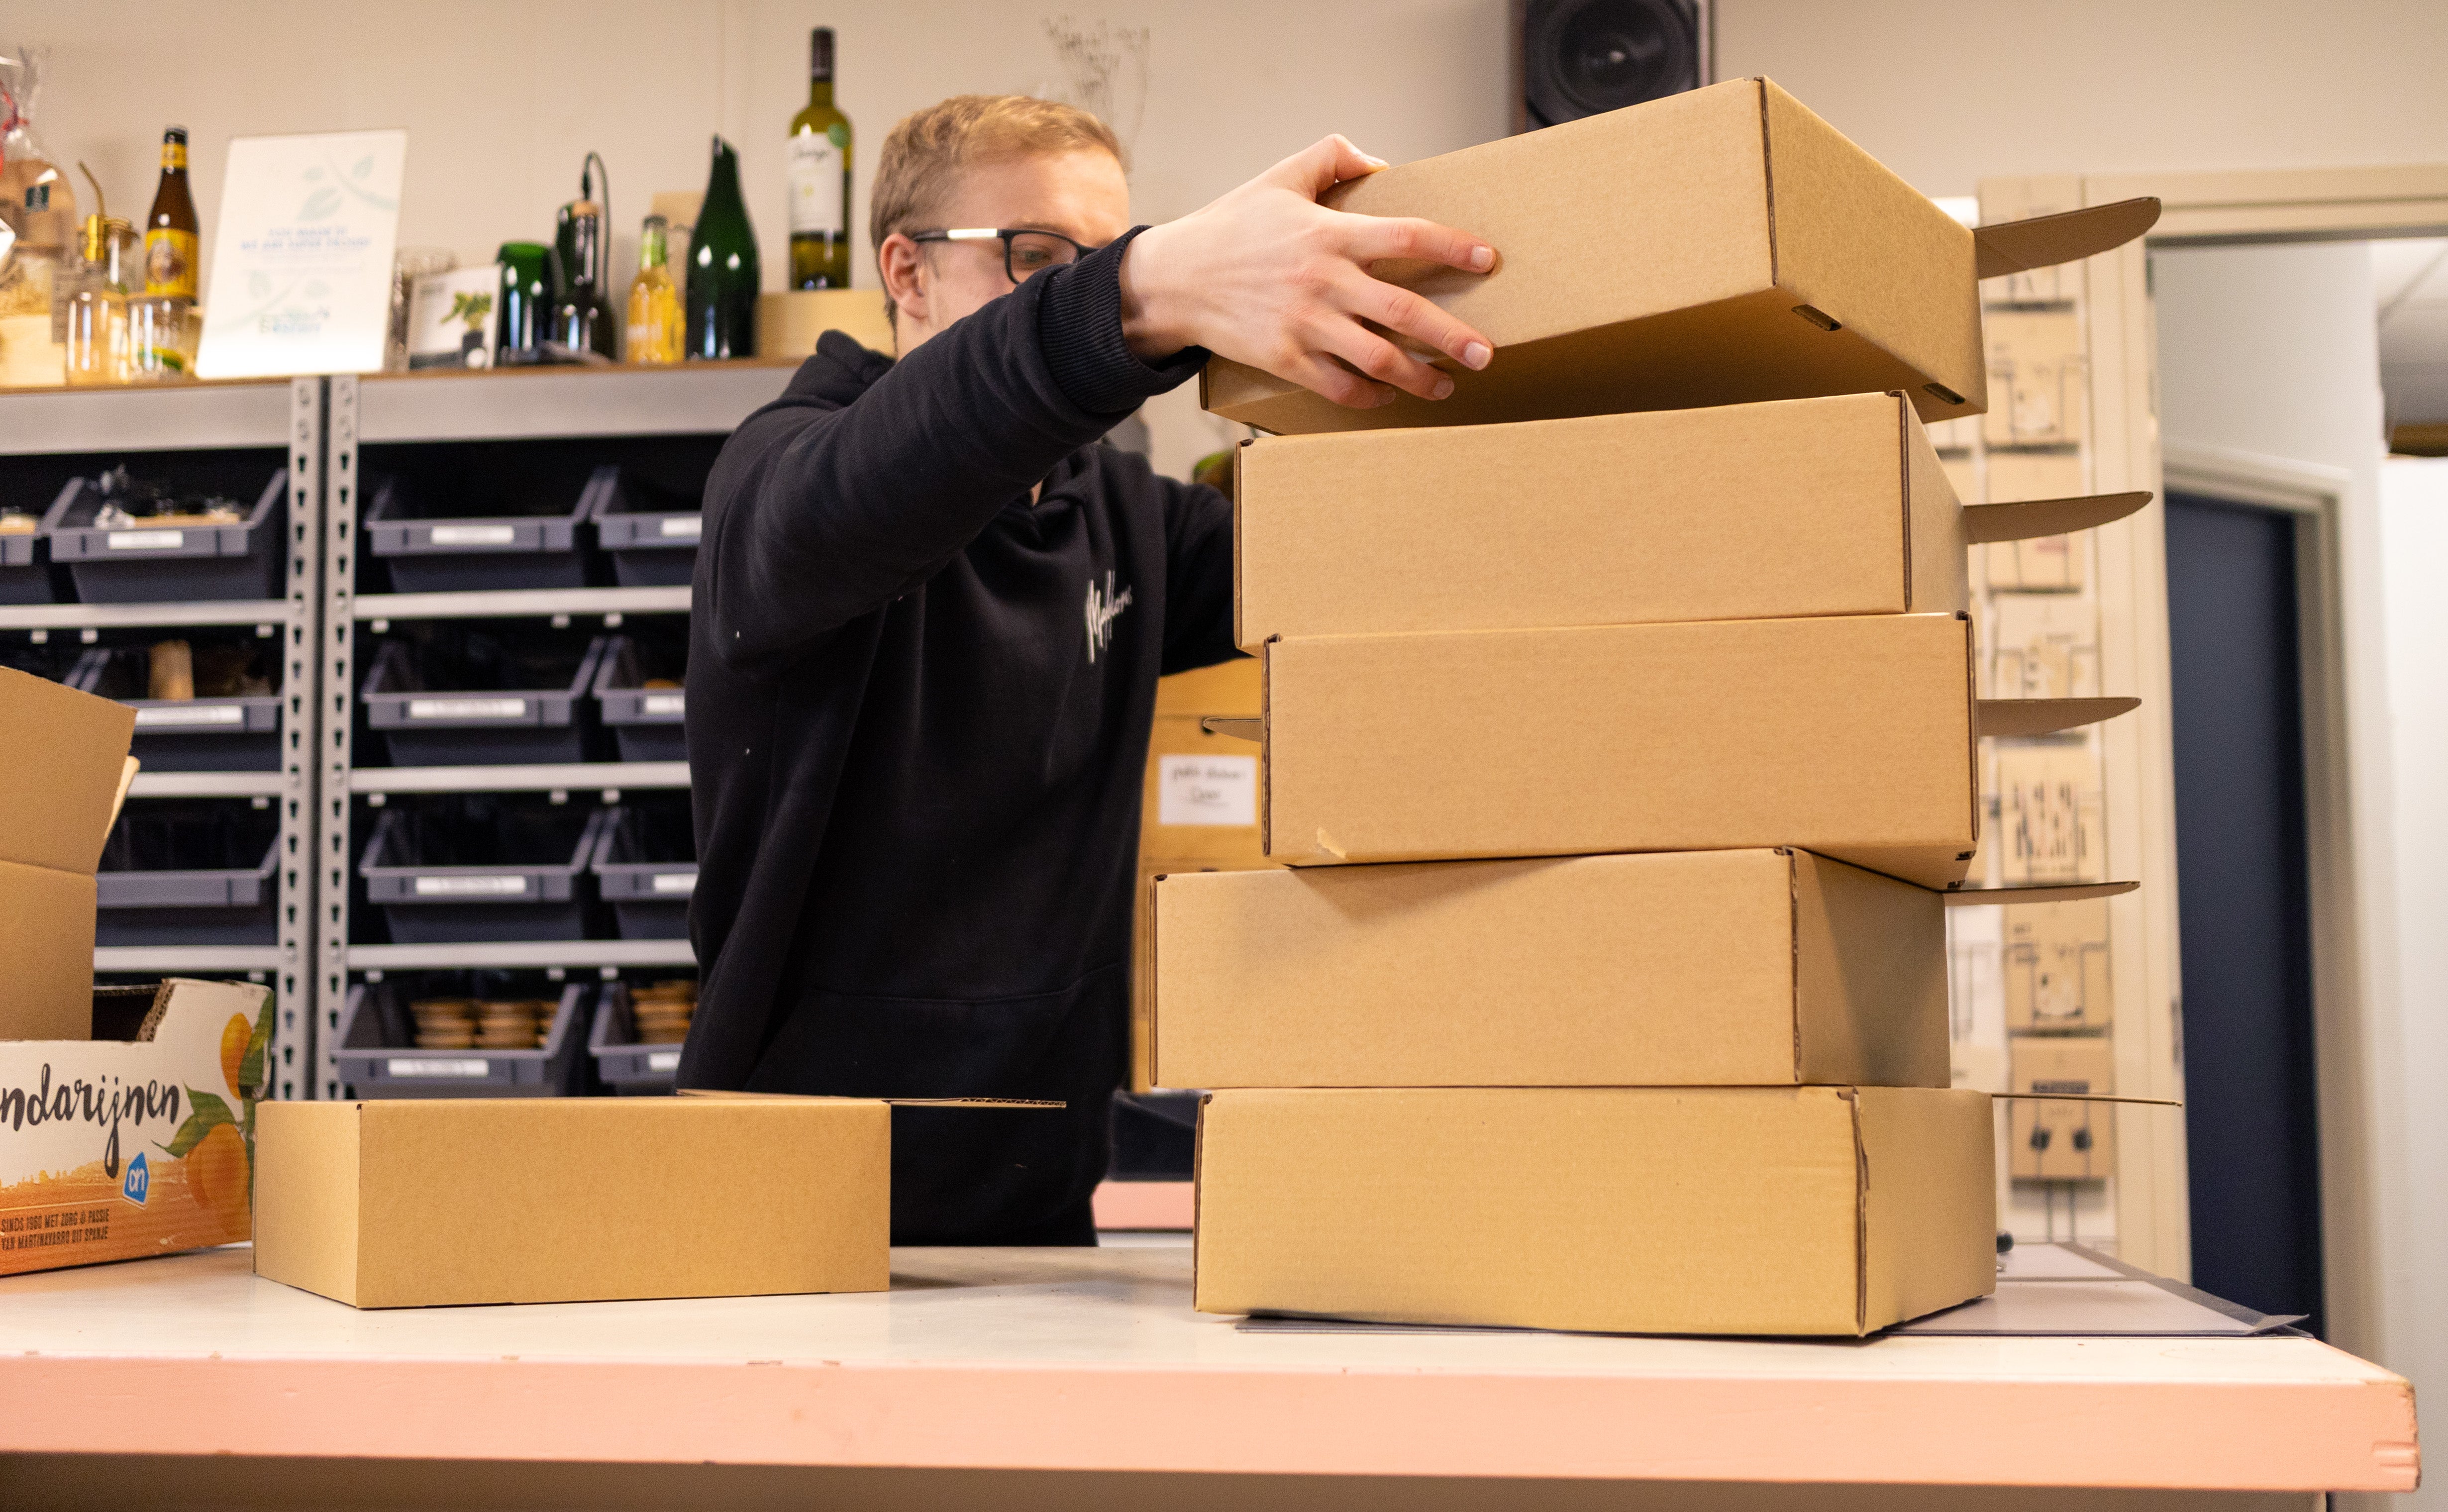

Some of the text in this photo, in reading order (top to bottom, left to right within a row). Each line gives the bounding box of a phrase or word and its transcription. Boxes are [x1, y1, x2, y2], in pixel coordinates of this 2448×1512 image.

[1, 1217, 24, 1232] SINDS
[45, 1213, 59, 1228] MET
[61, 1212, 78, 1226] ZORG
[88, 1209, 109, 1223] PASSIE
[1, 1236, 15, 1250] VAN
[72, 1229, 83, 1243] UIT
[85, 1226, 109, 1241] SPANJE
